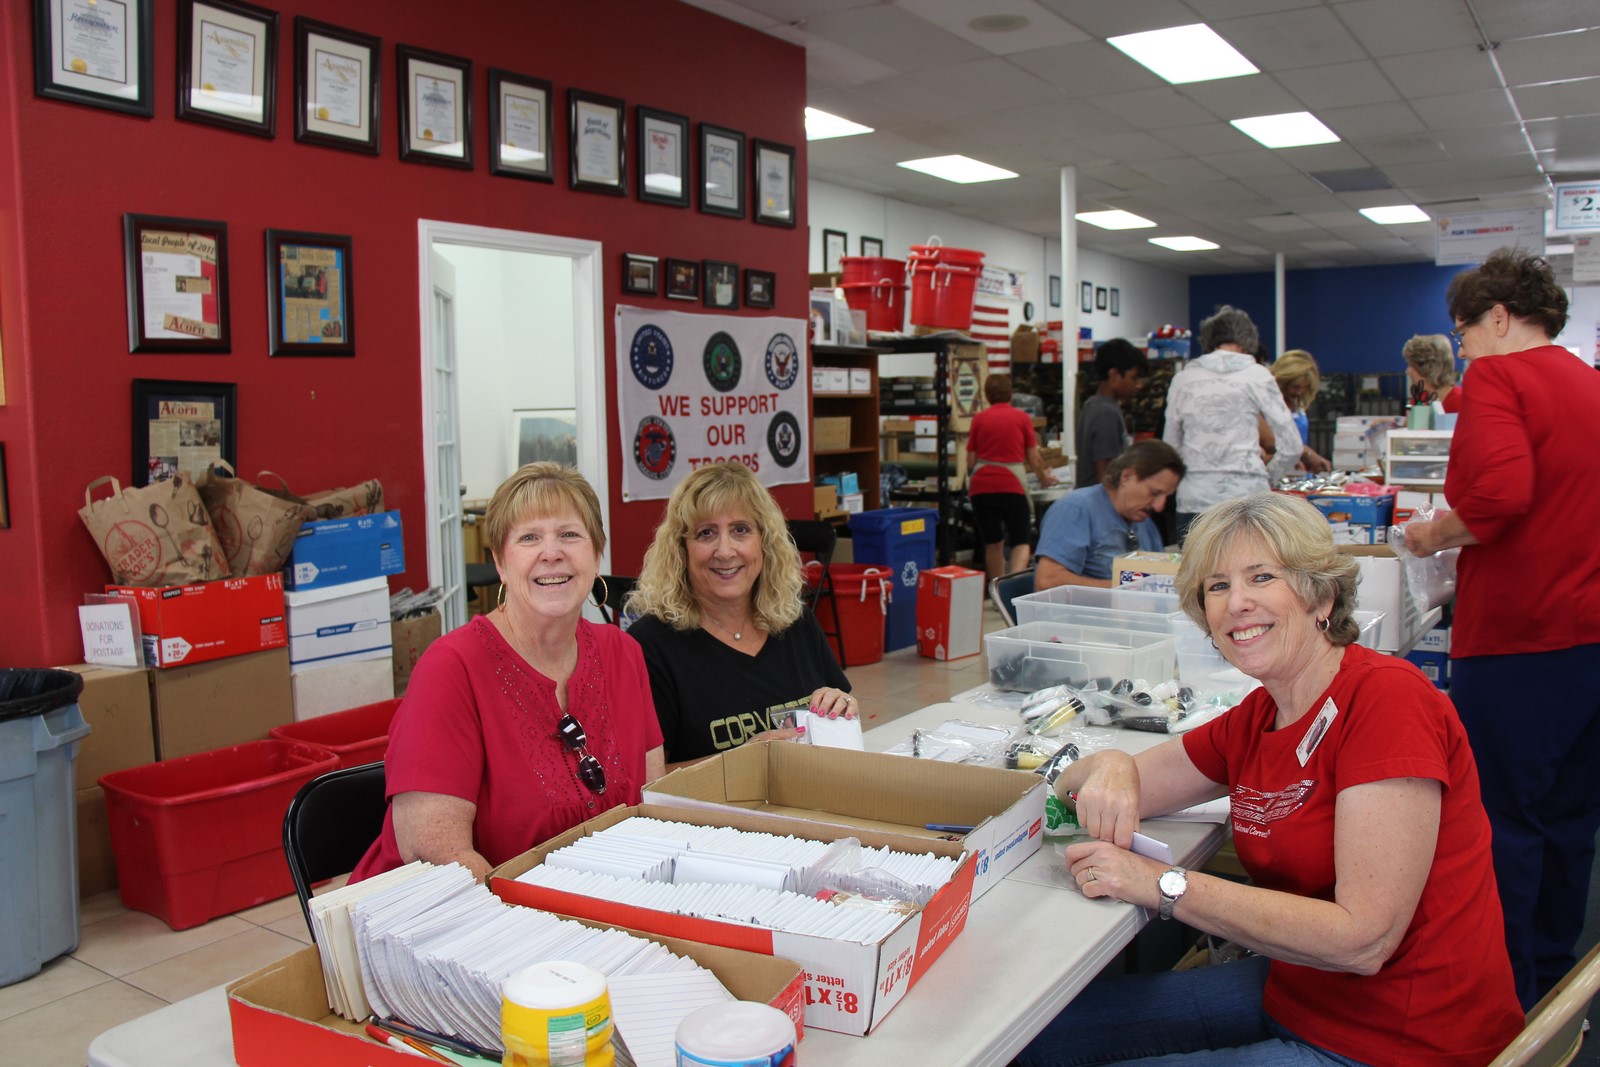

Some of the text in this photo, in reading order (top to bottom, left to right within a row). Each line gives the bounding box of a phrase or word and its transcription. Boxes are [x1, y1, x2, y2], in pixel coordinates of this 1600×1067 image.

[68, 12, 119, 33] Recognition
[161, 235, 185, 249] People
[187, 240, 198, 250] of
[197, 242, 215, 255] 2011
[169, 316, 205, 335] Acorn
[160, 401, 198, 415] Acorn
[659, 393, 779, 417] WE SUPPORT
[706, 423, 746, 446] OUR
[117, 538, 155, 571] TRADER
[86, 620, 124, 632] DONATIONS
[99, 634, 114, 644] FOR
[93, 647, 124, 657] POSTAGE
[919, 932, 938, 959] paper
[815, 974, 845, 988] letter
